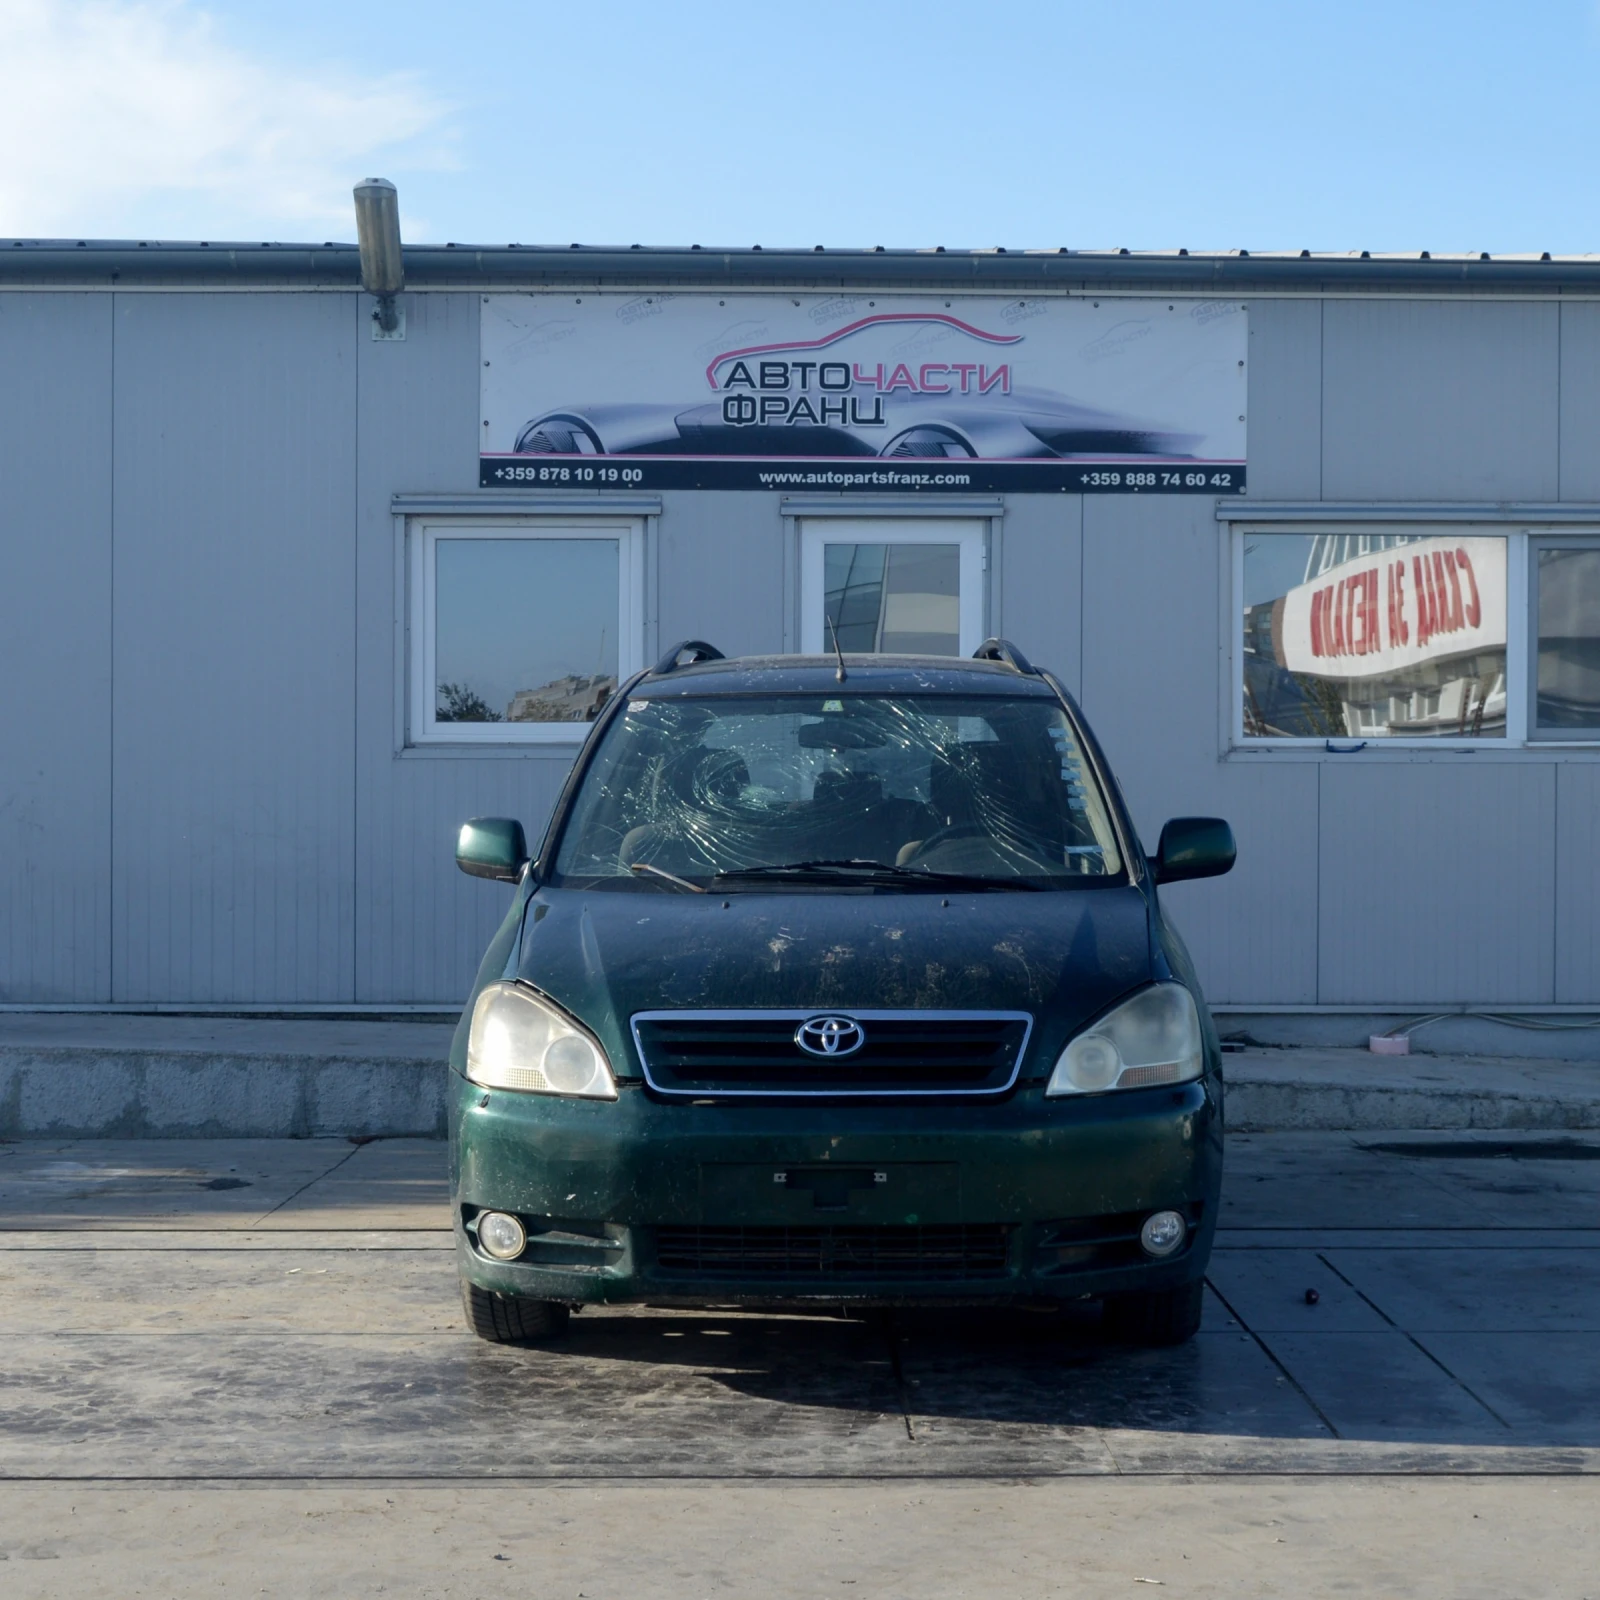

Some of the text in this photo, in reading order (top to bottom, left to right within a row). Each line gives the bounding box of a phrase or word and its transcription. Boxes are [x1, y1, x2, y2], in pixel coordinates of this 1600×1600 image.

[723, 361, 1009, 392] АВТОЧАСТИ
[722, 393, 886, 426] ФРАНЦ
[495, 467, 643, 482] +359 878 10 19 00
[759, 471, 970, 487] www.autopartsfranz.com
[1080, 472, 1231, 487] +359 888 74 60 42
